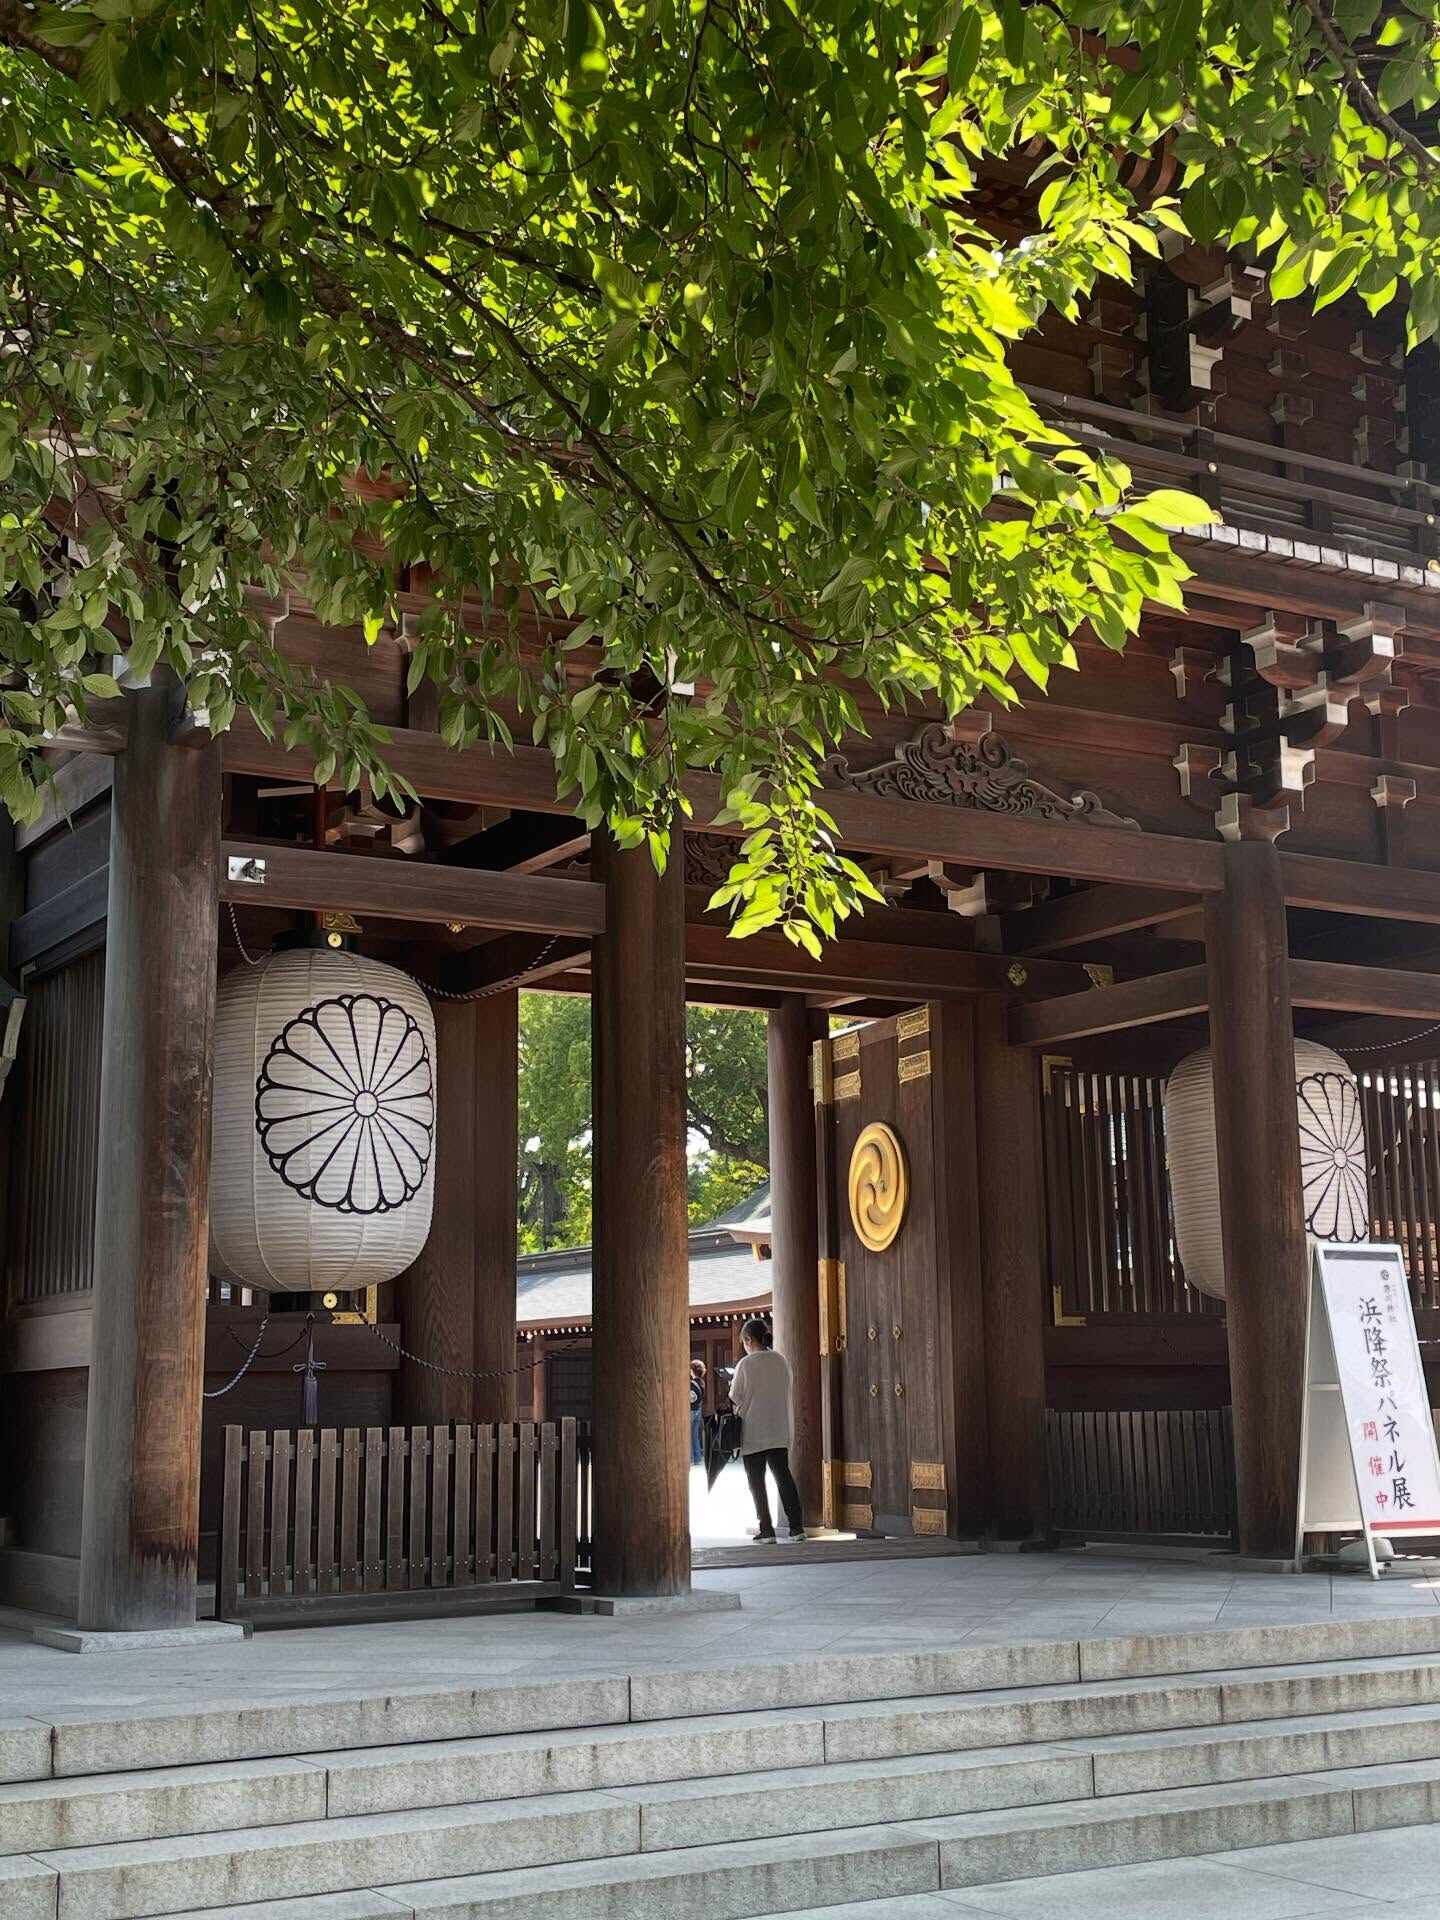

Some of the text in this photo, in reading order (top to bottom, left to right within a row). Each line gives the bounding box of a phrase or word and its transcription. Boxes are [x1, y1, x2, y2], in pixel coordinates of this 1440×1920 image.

[1360, 1297, 1415, 1510] 浜降祭パネル展
[1362, 1421, 1388, 1512] 開催中
